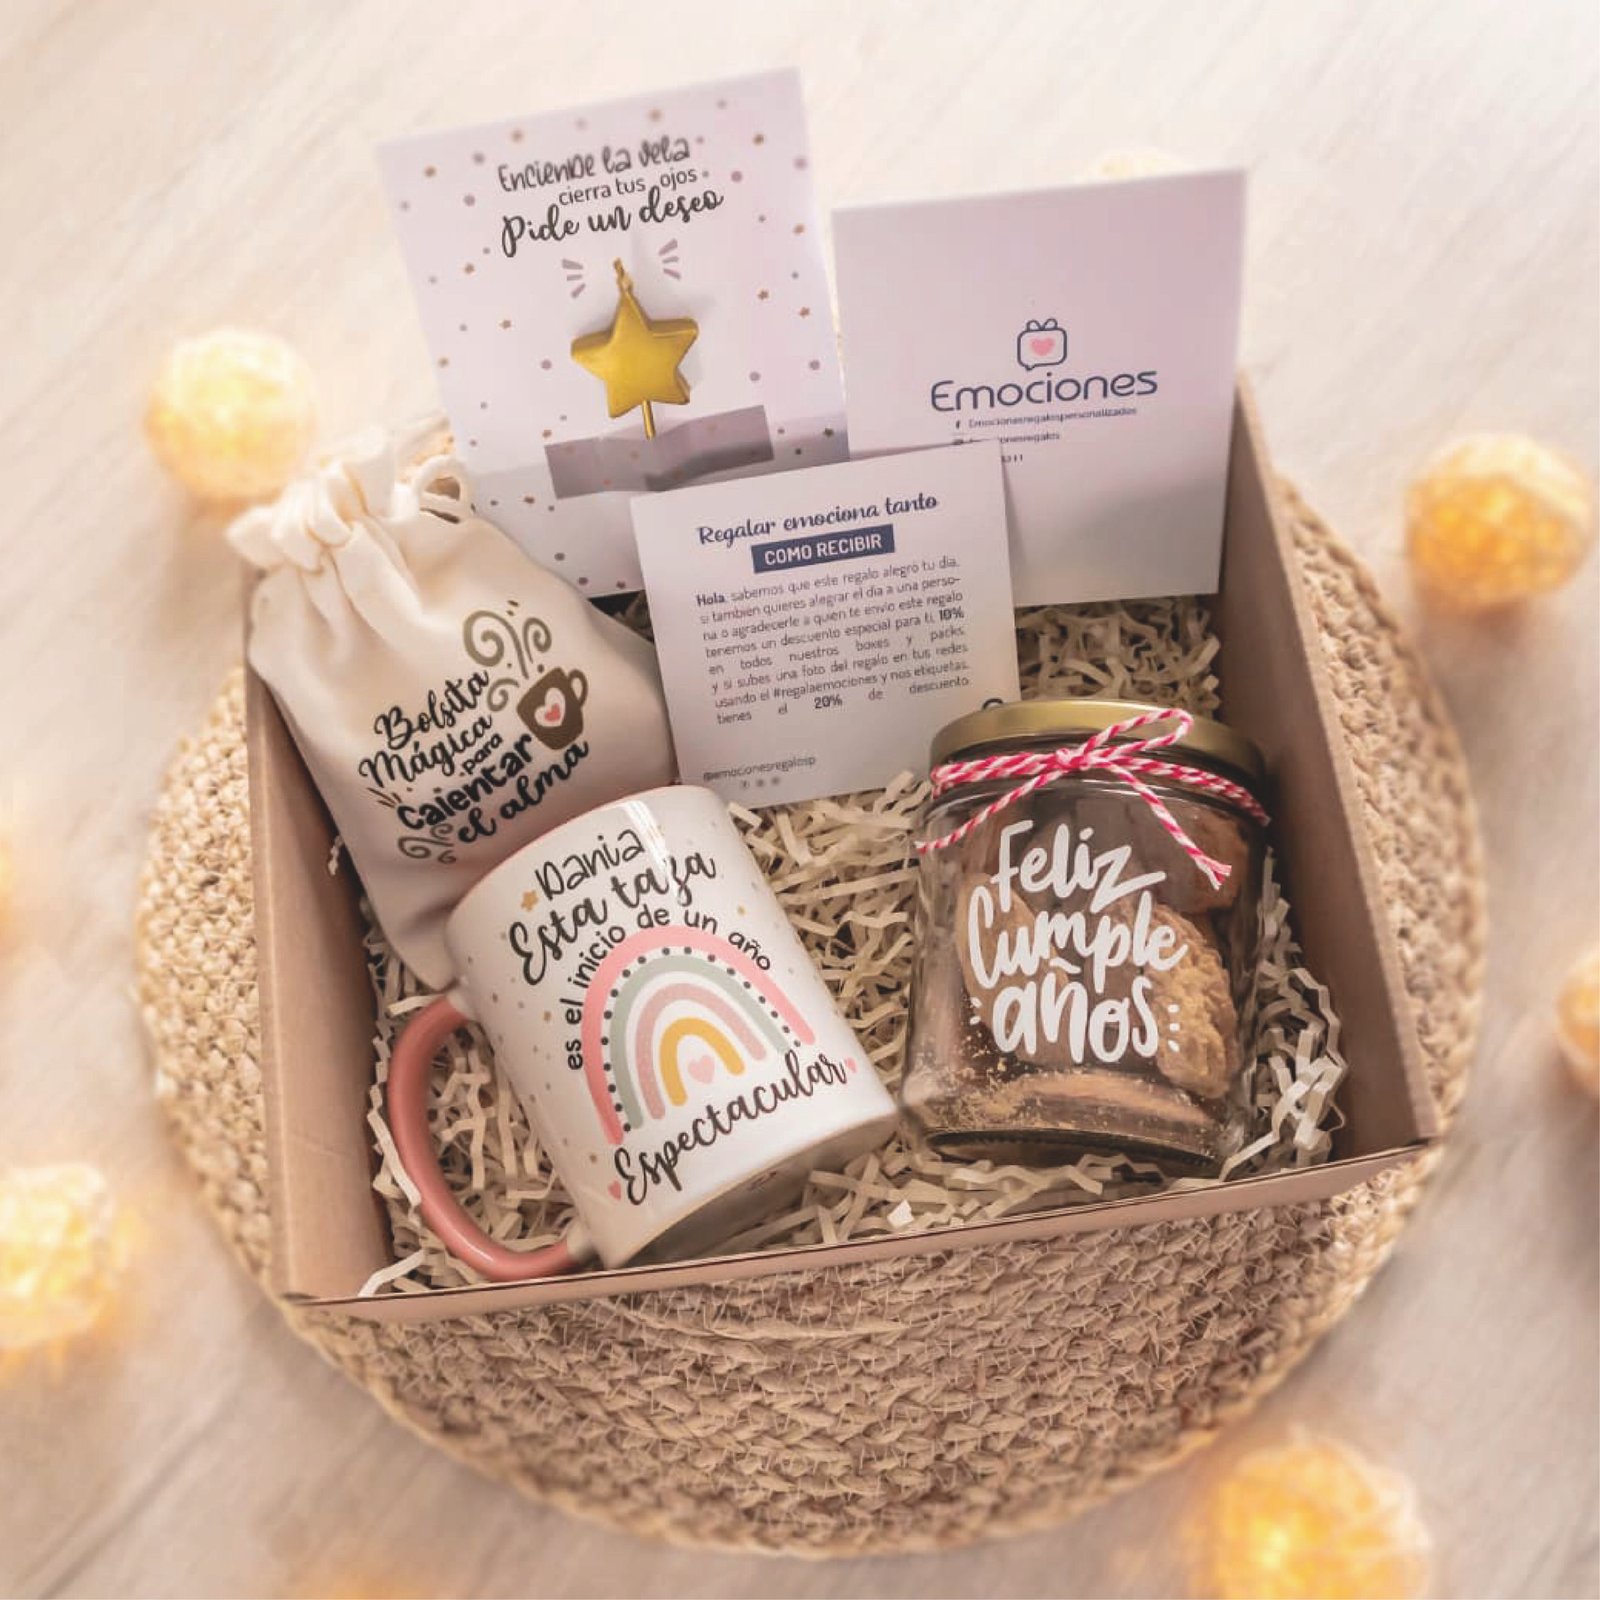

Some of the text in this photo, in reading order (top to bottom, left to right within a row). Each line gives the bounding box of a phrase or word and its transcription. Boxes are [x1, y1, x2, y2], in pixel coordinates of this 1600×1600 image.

[558, 167, 698, 206] cierra tus ojos
[602, 146, 632, 174] la
[501, 185, 725, 258] Pide un deseo
[931, 371, 1158, 412] Emociones
[697, 492, 938, 548] Regalar emociona tanto
[765, 534, 883, 566] COMO RECIBIR
[730, 586, 784, 602] sabemos
[788, 581, 810, 594] que
[814, 573, 838, 587] este
[843, 568, 879, 586] regalo
[922, 560, 935, 571] tu
[763, 600, 806, 616] quieres
[809, 592, 849, 607] alegrar
[853, 587, 863, 599] el
[886, 585, 894, 595] a
[897, 582, 918, 593] una
[703, 631, 717, 641] na
[721, 629, 729, 638] o
[731, 615, 800, 640] agradecerle
[813, 609, 846, 625] quien
[849, 607, 861, 618] te
[899, 597, 923, 610] este
[927, 590, 963, 607] regalo
[706, 643, 757, 658] tenemos
[761, 639, 776, 649] un
[781, 628, 840, 646] descuento
[844, 619, 891, 636] especial
[895, 616, 921, 631] para
[940, 606, 965, 621] 10%
[708, 664, 724, 674] en
[740, 654, 773, 670] todos
[789, 646, 839, 662] nuestros
[856, 638, 889, 652] boxes
[906, 635, 913, 647] y
[712, 681, 719, 695] y
[737, 674, 771, 688] subes
[776, 669, 798, 681] una
[802, 664, 826, 677] foto
[830, 660, 847, 674] del
[853, 653, 888, 670] regalo
[892, 652, 907, 663] en
[912, 648, 931, 660] tus
[935, 642, 968, 656] redes
[374, 670, 490, 750] Bolsita
[715, 693, 757, 708] usando
[760, 688, 770, 701] el
[880, 673, 887, 684] y
[890, 669, 911, 681] nos
[717, 676, 969, 724] tienes el 20% de descuento
[358, 715, 493, 788] Mágica
[462, 733, 503, 775] para
[458, 741, 589, 843] el alma
[535, 829, 645, 900] Dania
[990, 820, 1166, 914] Feliz
[509, 851, 717, 985] Esta taza
[968, 885, 1189, 994] Cumple
[560, 904, 771, 1070] es el inicio de un año
[993, 956, 1159, 1064] años
[614, 1048, 847, 1206] Espectacular
